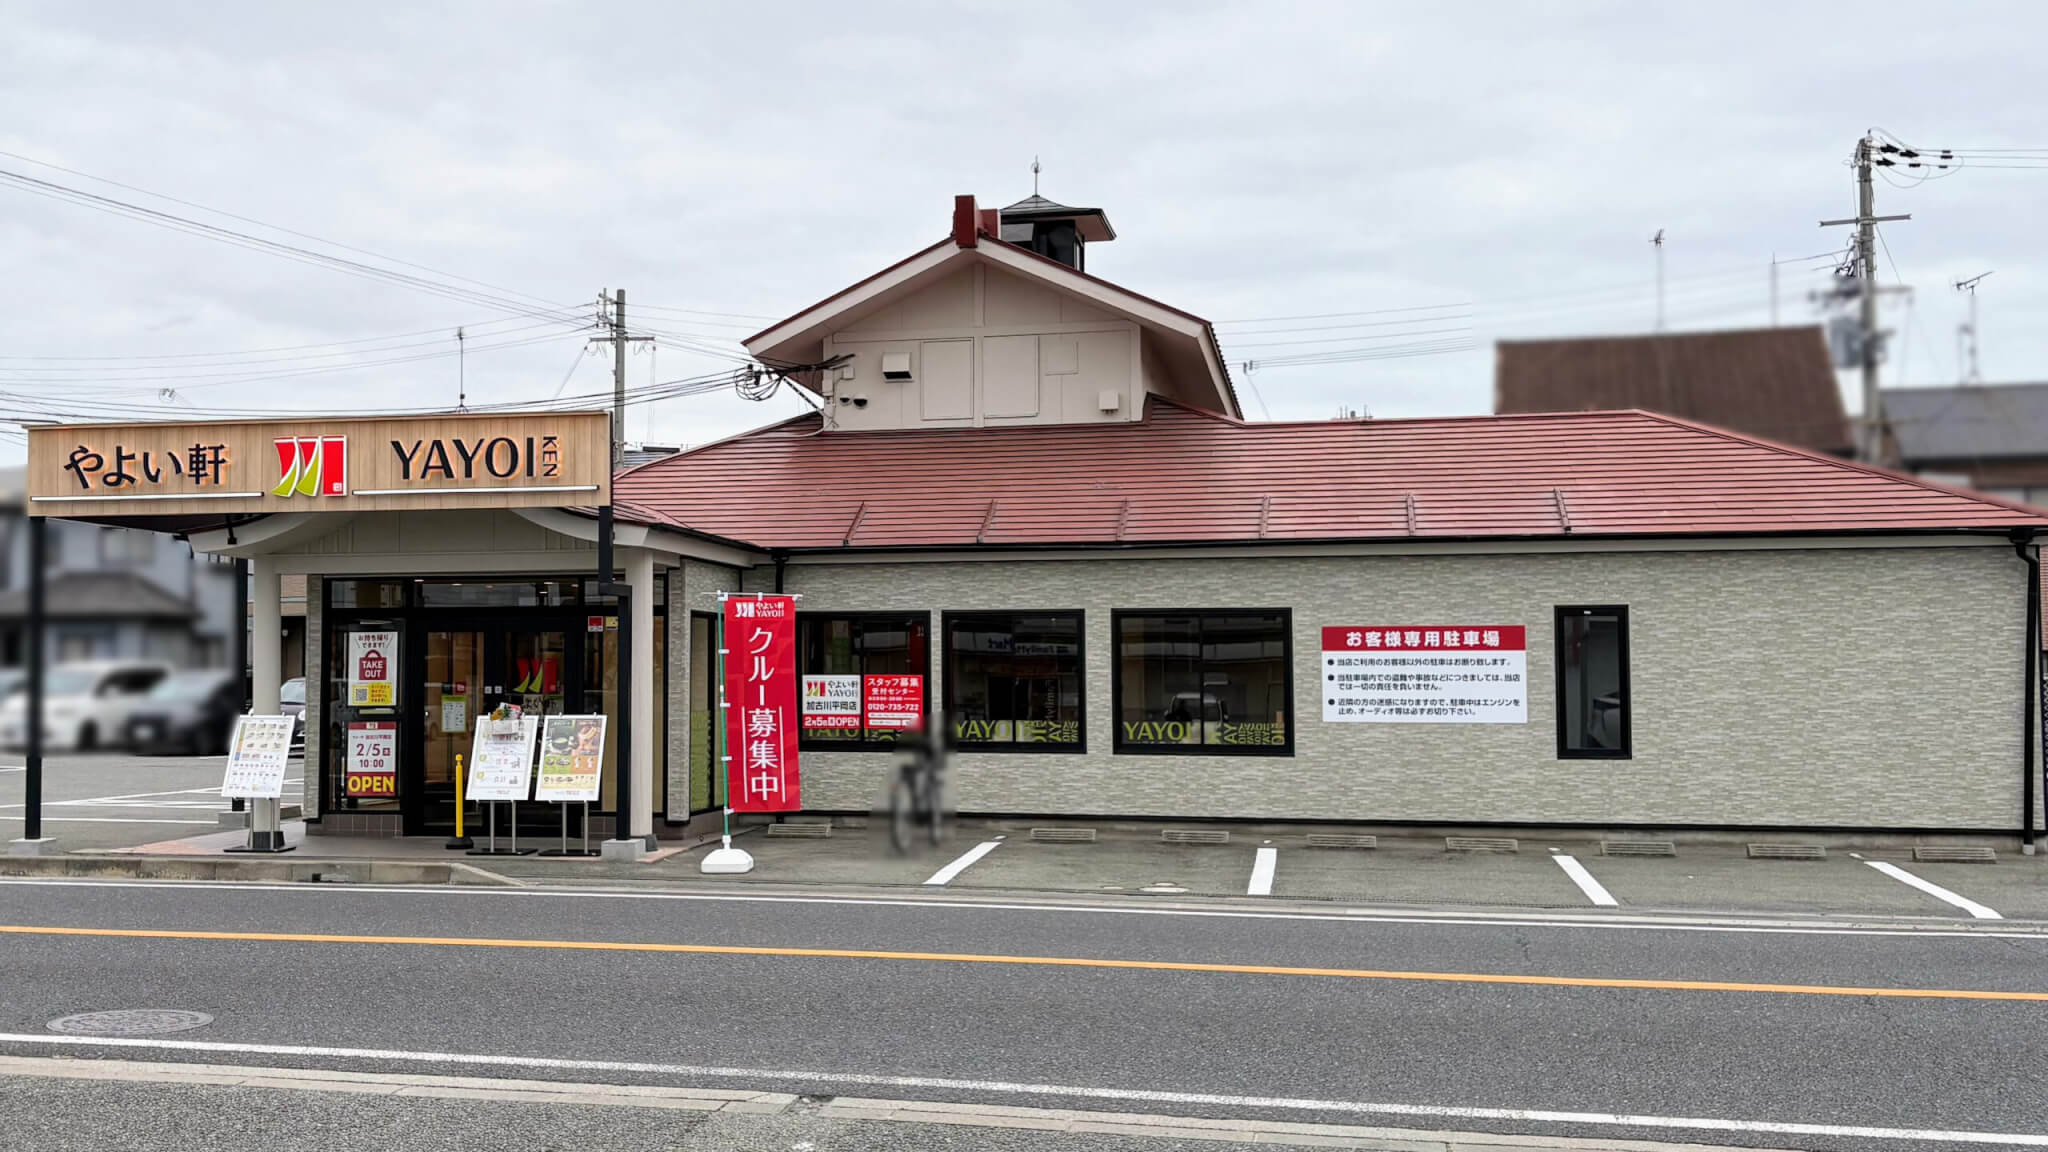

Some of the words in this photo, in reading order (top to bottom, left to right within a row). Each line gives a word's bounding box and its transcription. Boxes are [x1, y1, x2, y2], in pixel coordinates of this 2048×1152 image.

[390, 437, 535, 480] YAYOI
[542, 436, 558, 477] KEN
[63, 444, 227, 490] やよい軒
[1346, 631, 1500, 647] お客様専用駐車場
[361, 661, 384, 669] TAKE
[364, 670, 382, 678] OUT
[828, 680, 858, 689] やよい軒
[868, 678, 919, 687] スタッフ募集
[871, 687, 916, 695] 受付センター
[807, 701, 857, 711] 加古川平岡店
[748, 627, 779, 801] クルー募集中
[1123, 721, 1192, 741] YAYOI
[359, 759, 384, 768] 10:00
[348, 775, 395, 792] OPEN
